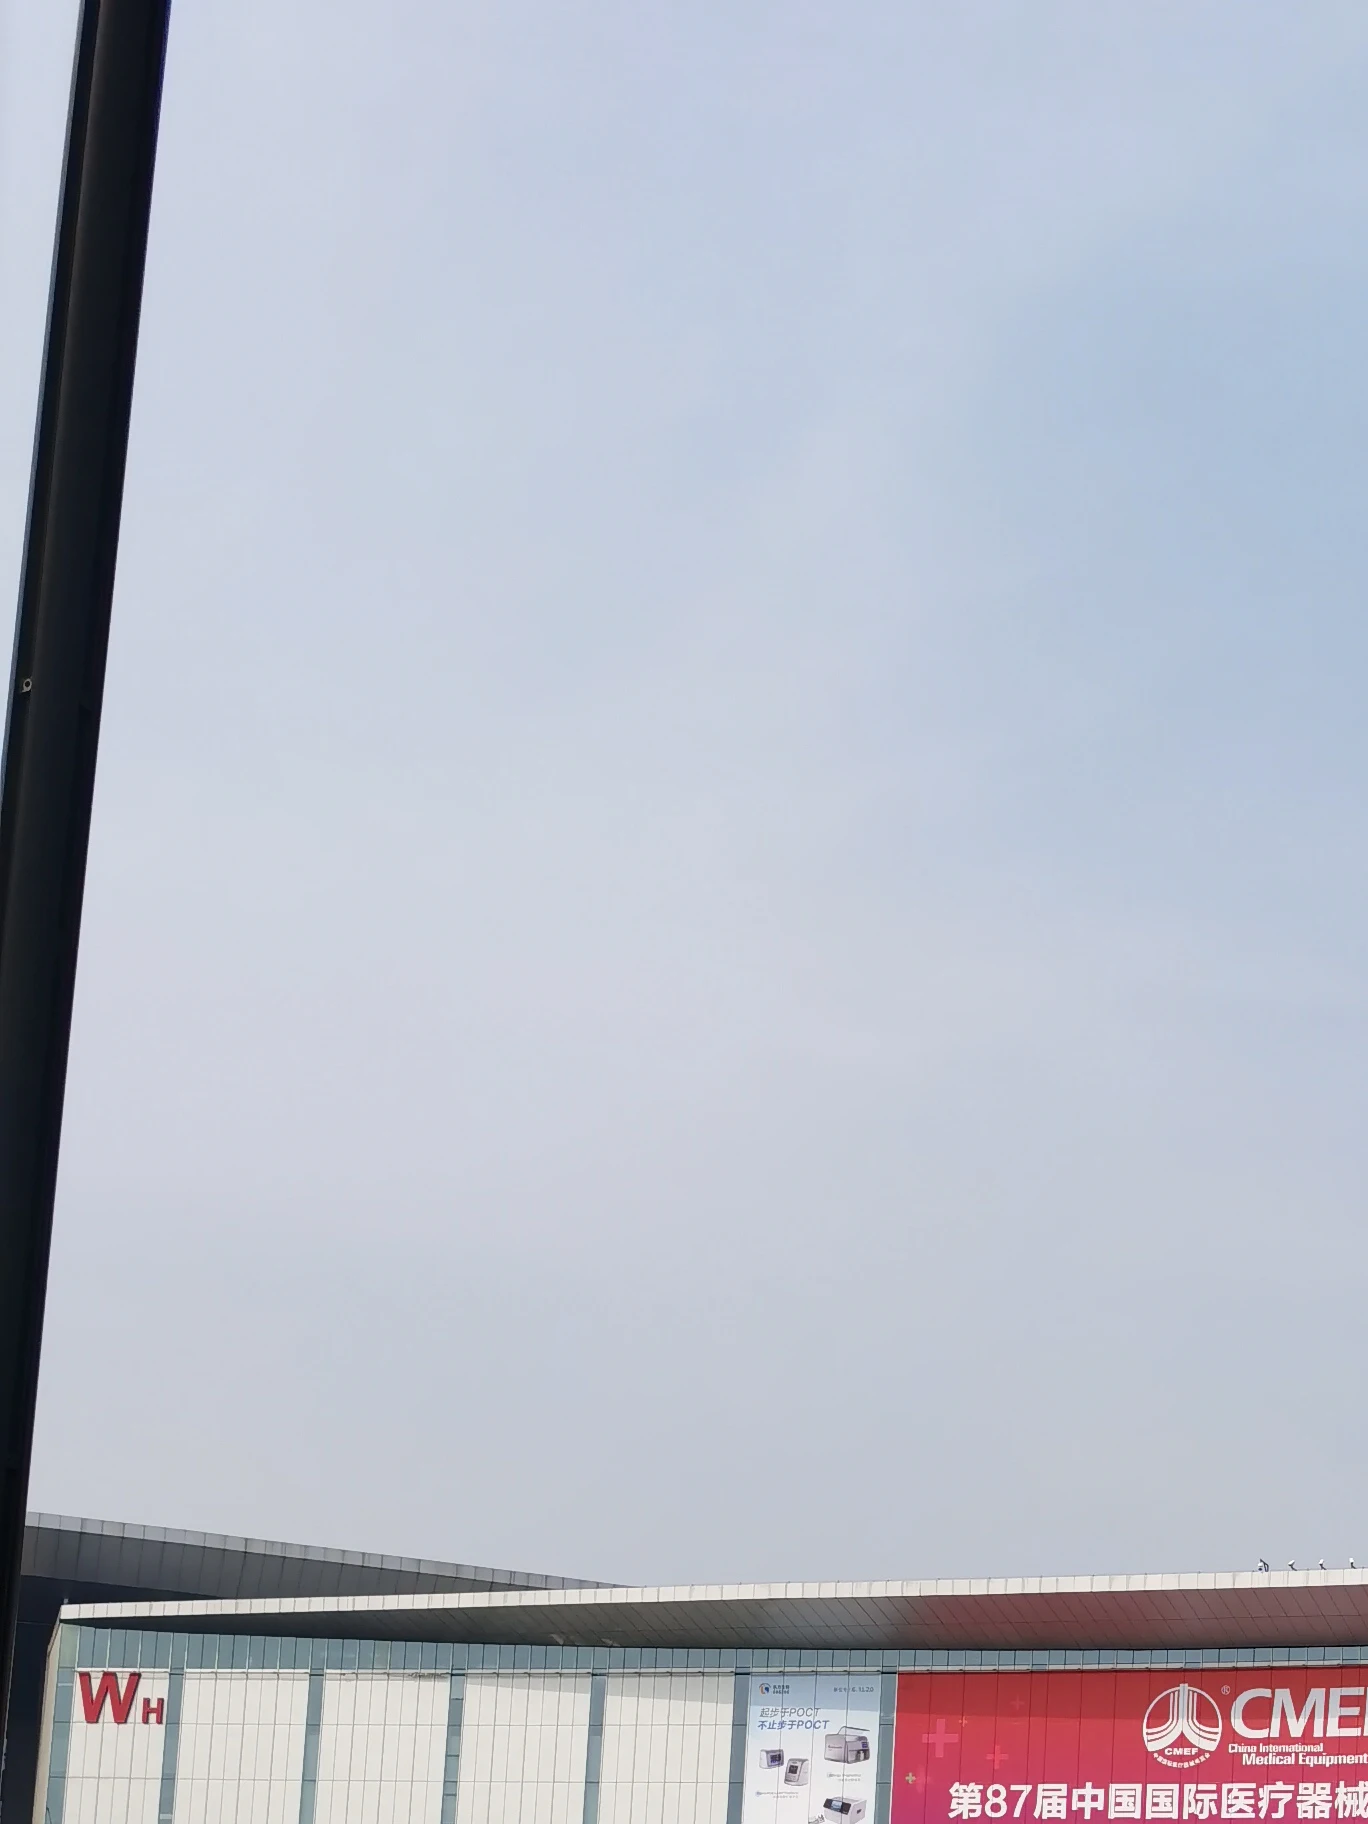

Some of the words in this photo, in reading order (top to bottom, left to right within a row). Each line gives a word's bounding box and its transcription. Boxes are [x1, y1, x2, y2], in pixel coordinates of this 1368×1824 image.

[757, 1720, 830, 1730] 不止步于POCT
[1164, 1747, 1199, 1756] CMEF
[1228, 1743, 1257, 1753] China
[1259, 1742, 1324, 1753] International
[1242, 1753, 1296, 1766] Medical
[1298, 1752, 1368, 1767] Equipment
